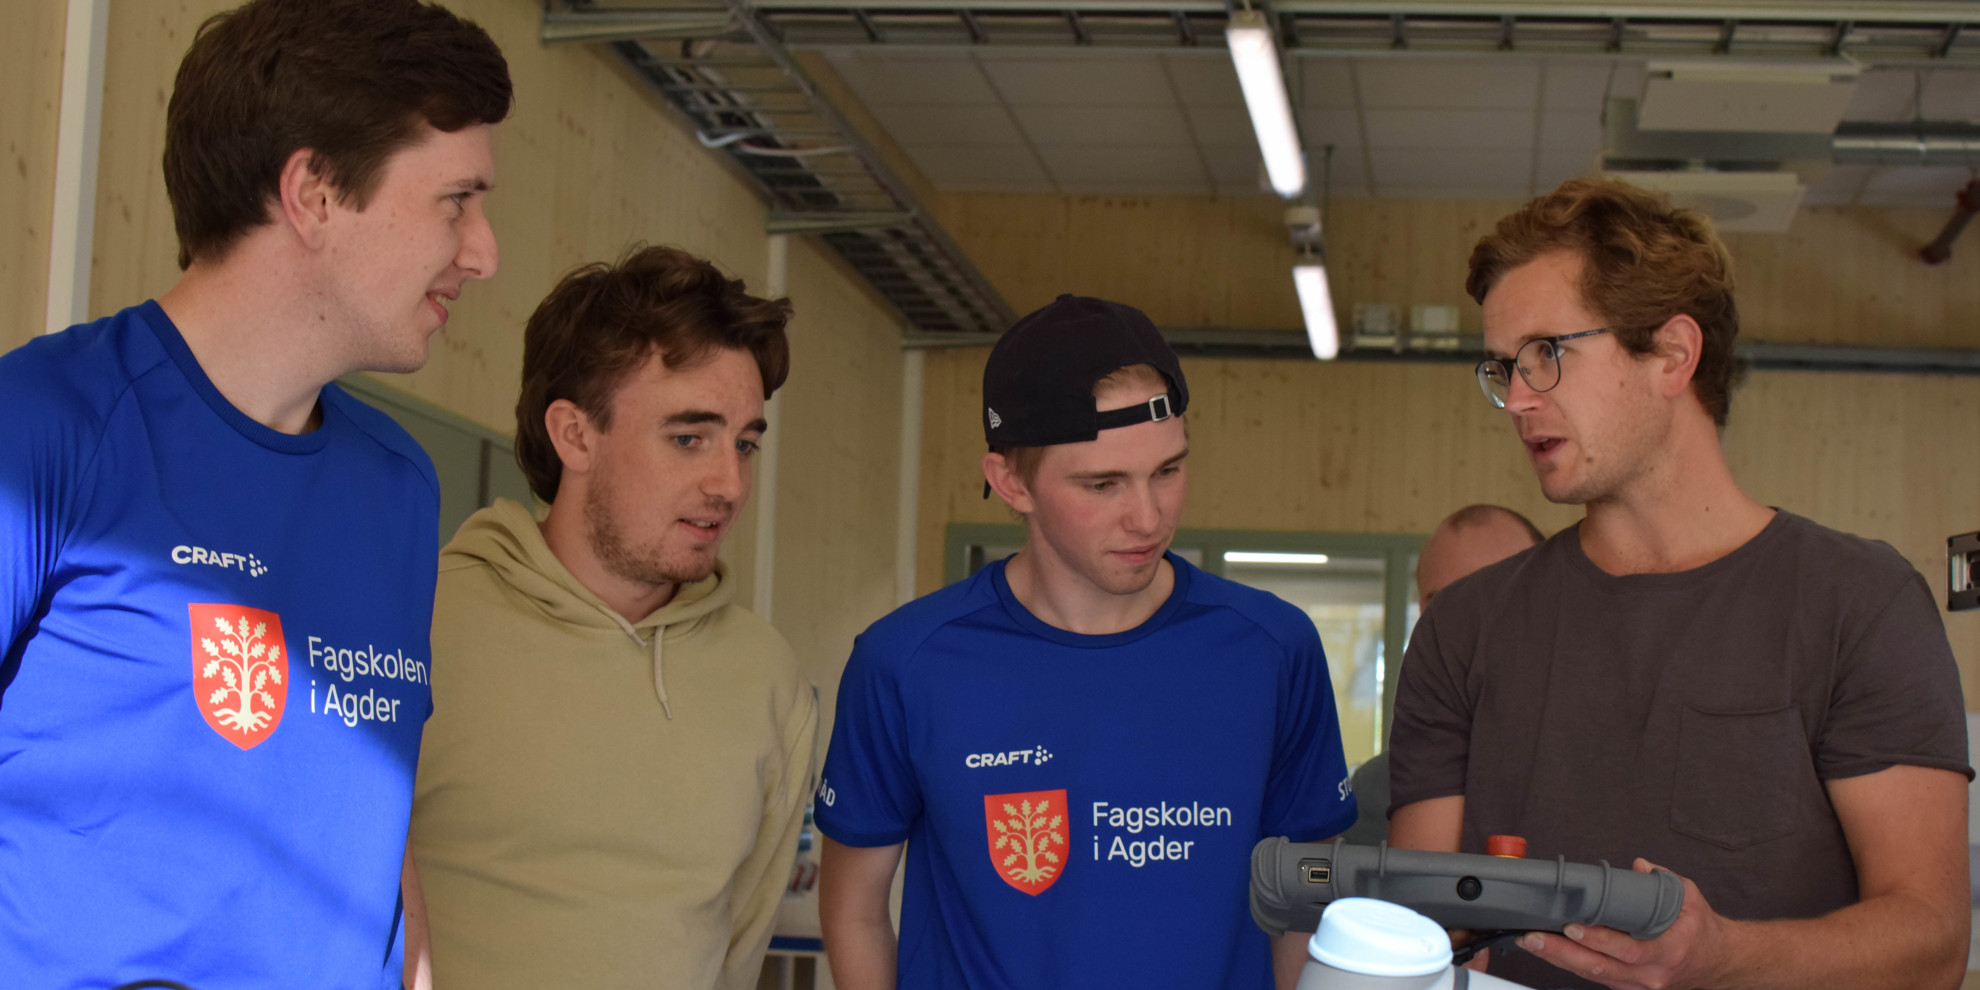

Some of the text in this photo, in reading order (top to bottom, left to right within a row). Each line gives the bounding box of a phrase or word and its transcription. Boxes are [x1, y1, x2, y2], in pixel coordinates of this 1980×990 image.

[171, 545, 247, 572] CRAFT
[308, 635, 428, 686] Fagskolen
[310, 680, 401, 728] i Agder
[965, 749, 1034, 769] CRAFT
[817, 778, 836, 807] ÅD
[1093, 801, 1232, 834] Fagskolen
[1093, 835, 1195, 868] i Agder
